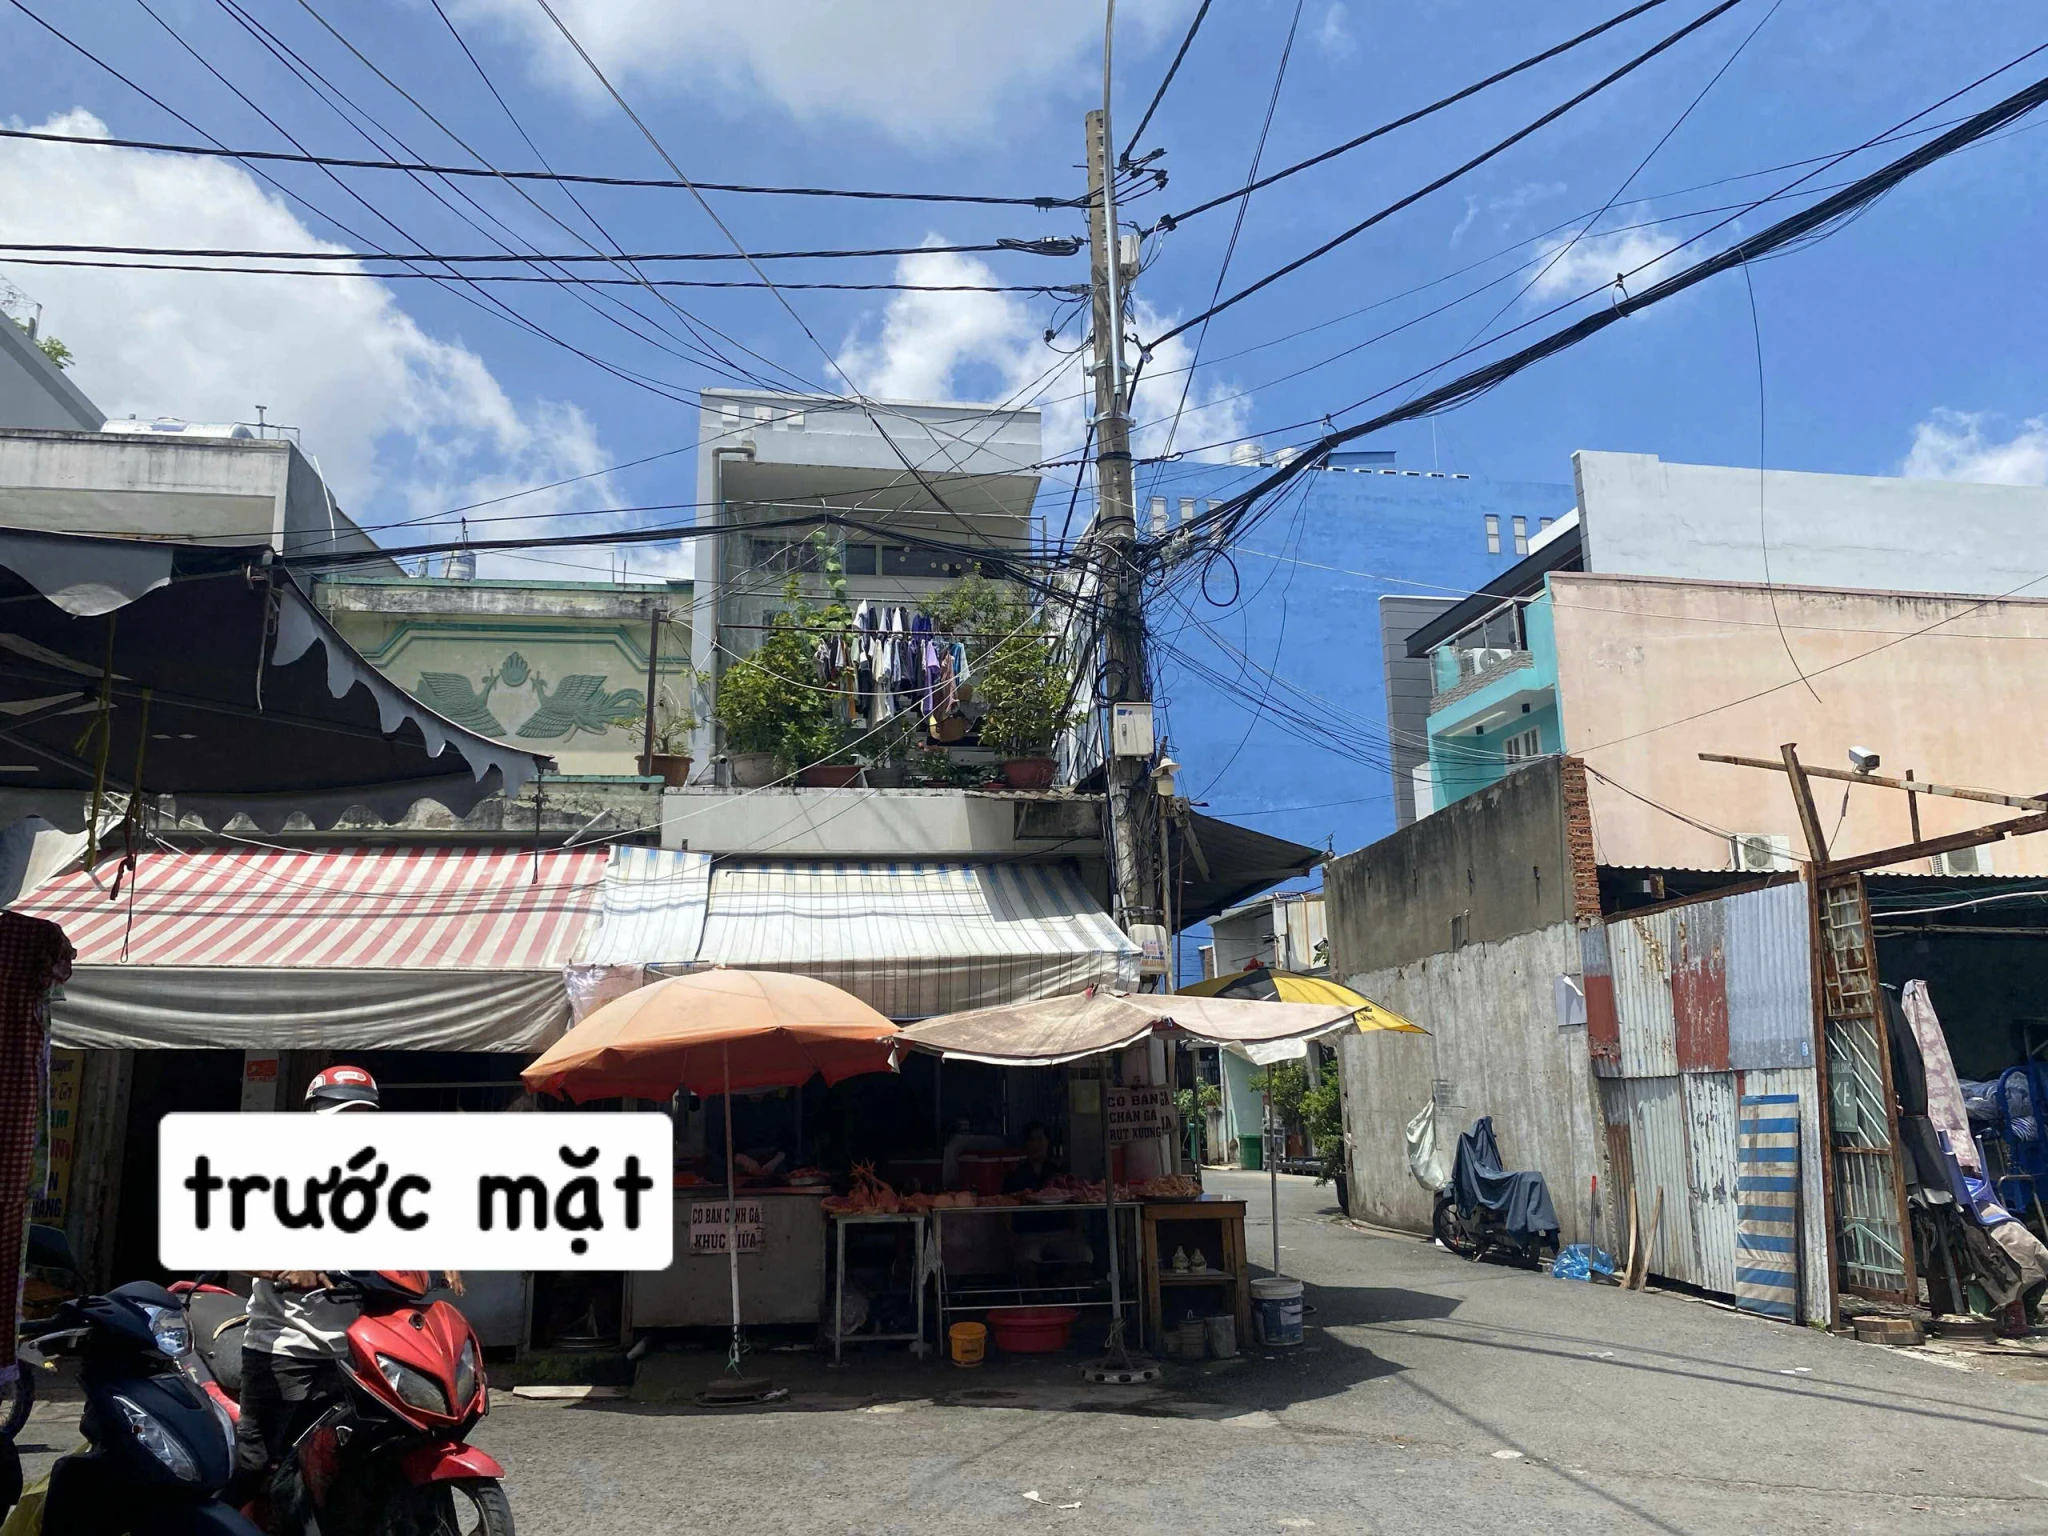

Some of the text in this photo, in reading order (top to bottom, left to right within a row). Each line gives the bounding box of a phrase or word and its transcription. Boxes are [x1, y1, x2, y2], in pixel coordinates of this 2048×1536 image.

[724, 1206, 747, 1224] CNH
[694, 1229, 757, 1249] KHÚC IỮA
